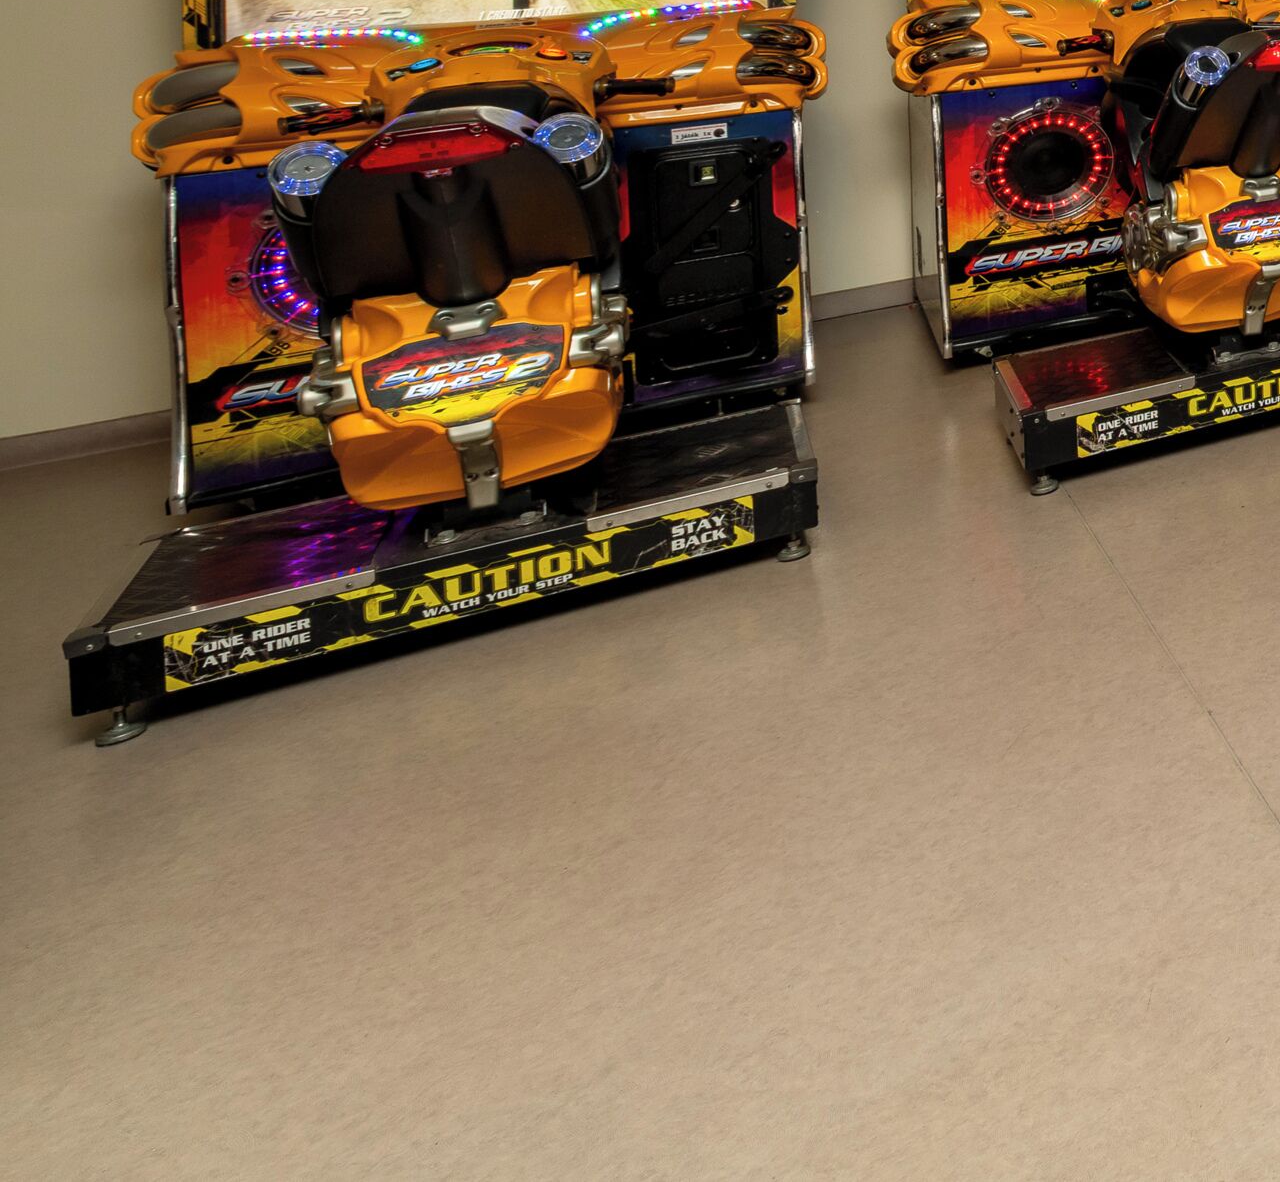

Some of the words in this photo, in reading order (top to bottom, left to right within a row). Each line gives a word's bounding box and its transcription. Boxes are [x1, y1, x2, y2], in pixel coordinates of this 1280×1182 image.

[270, 6, 370, 21] SUPER
[487, 8, 521, 20] CREDIT
[536, 5, 567, 18] START
[972, 241, 1086, 272] SUPER
[379, 353, 503, 389] SUPER
[402, 367, 510, 401] BIKES
[506, 353, 551, 380] 2
[1098, 418, 1123, 432] ONE
[1125, 410, 1159, 426] RIDER
[1221, 400, 1255, 416] WATCH
[1098, 431, 1115, 442] AT
[1118, 428, 1127, 438] A
[1132, 421, 1159, 435] TIME
[670, 527, 727, 552] BACK
[671, 514, 726, 538] STAY
[363, 539, 613, 624] CAUTION
[422, 593, 481, 619] WATCH
[485, 582, 531, 605] YOUR
[535, 574, 574, 592] STEP
[202, 633, 244, 655] ONE
[251, 618, 311, 642] RIDER
[202, 650, 230, 668] AT
[240, 646, 254, 659] A
[265, 630, 311, 654] TIME
